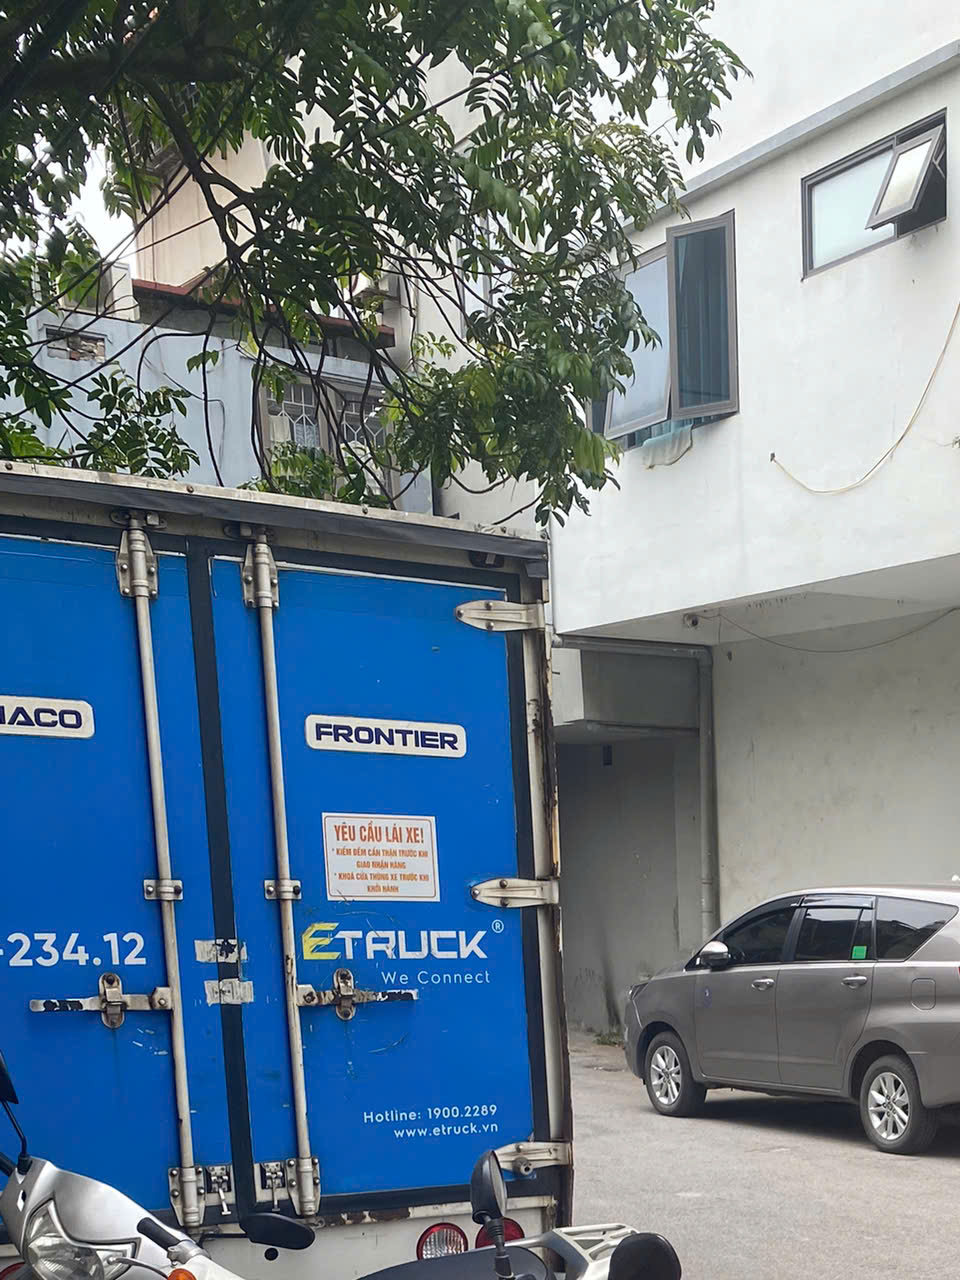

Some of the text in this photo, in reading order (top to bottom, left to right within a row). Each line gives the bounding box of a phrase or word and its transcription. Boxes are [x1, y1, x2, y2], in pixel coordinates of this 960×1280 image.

[0, 705, 83, 729] ACO
[315, 722, 459, 750] FRONTIER
[334, 820, 424, 844] YÊU CẦU LÁI XE!
[301, 922, 488, 960] ETRUCK
[381, 970, 491, 985] We Connect
[363, 1104, 498, 1124] Hotline: 1900.2289
[393, 1122, 499, 1139] www.etruck.vn
